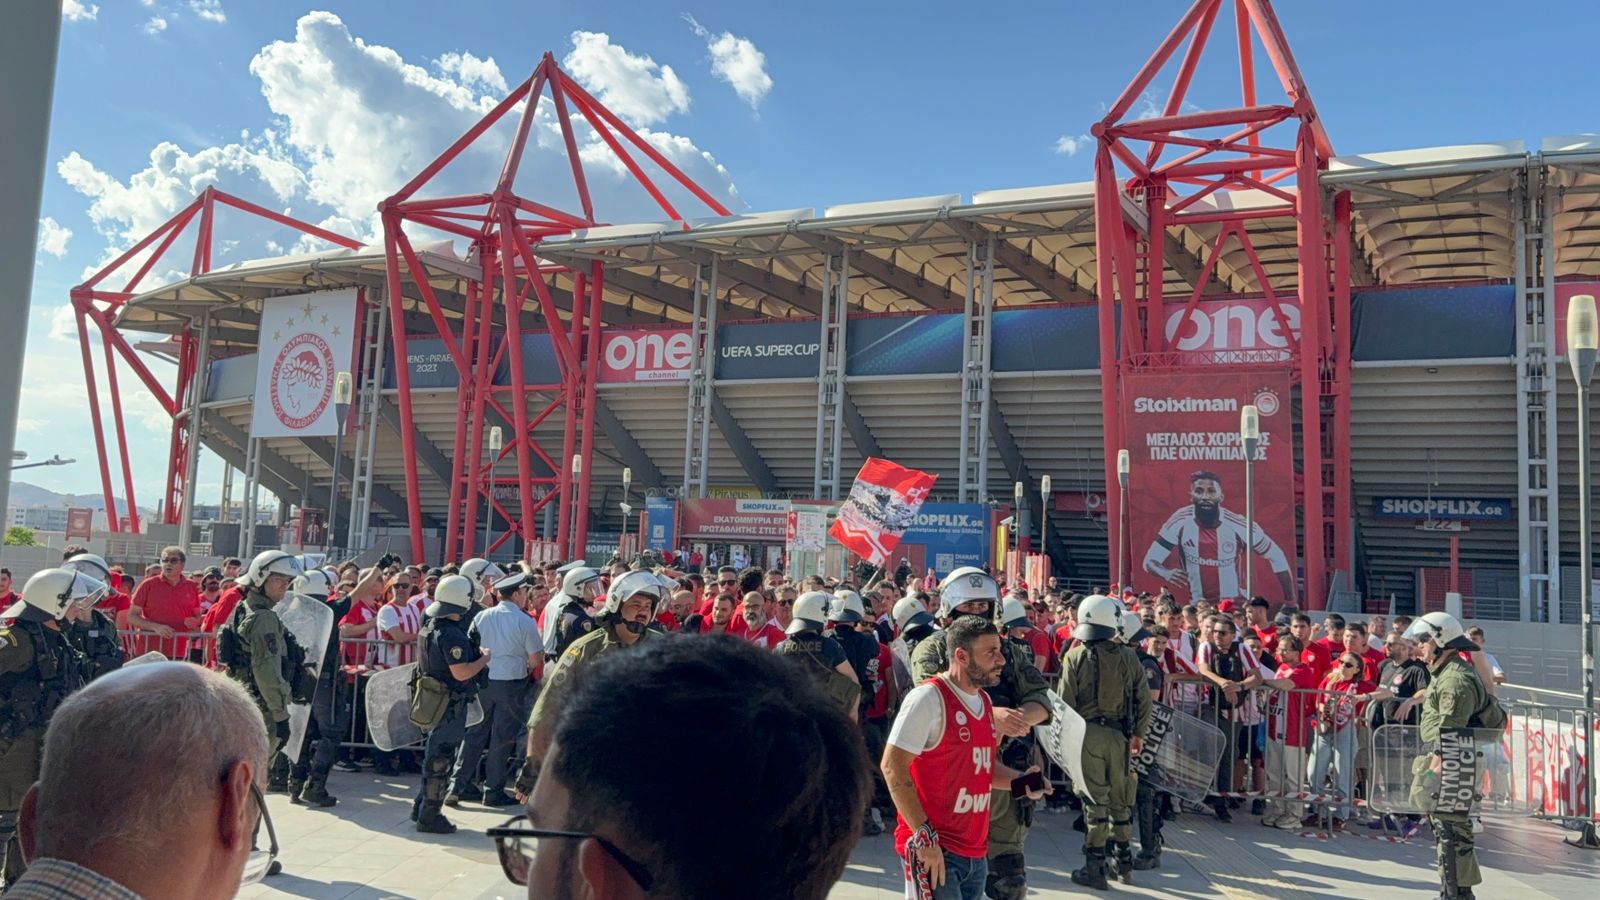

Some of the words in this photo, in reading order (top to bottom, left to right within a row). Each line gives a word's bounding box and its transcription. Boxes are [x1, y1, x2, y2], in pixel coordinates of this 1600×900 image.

[1166, 303, 1300, 350] one
[605, 333, 693, 370] one
[722, 346, 752, 358] UEFA
[754, 344, 794, 357] SUPER
[794, 343, 819, 355] CUP
[416, 364, 438, 372] 2023
[648, 371, 679, 379] channel
[1134, 397, 1238, 413] Stoiximan
[1146, 432, 1206, 447] ΜΕΓΑΛΟΣ
[1207, 432, 1271, 446] ΧΟΡΗΟΣ
[1150, 447, 1176, 460] ΠΑΕ
[1382, 499, 1503, 515] SHOPFLIX.GR
[1136, 710, 1171, 776] POLICE
[972, 746, 992, 775] 94
[1436, 731, 1461, 813] ΑΣΤΥΝΟΜΙΑ
[1455, 736, 1475, 811] POLICE
